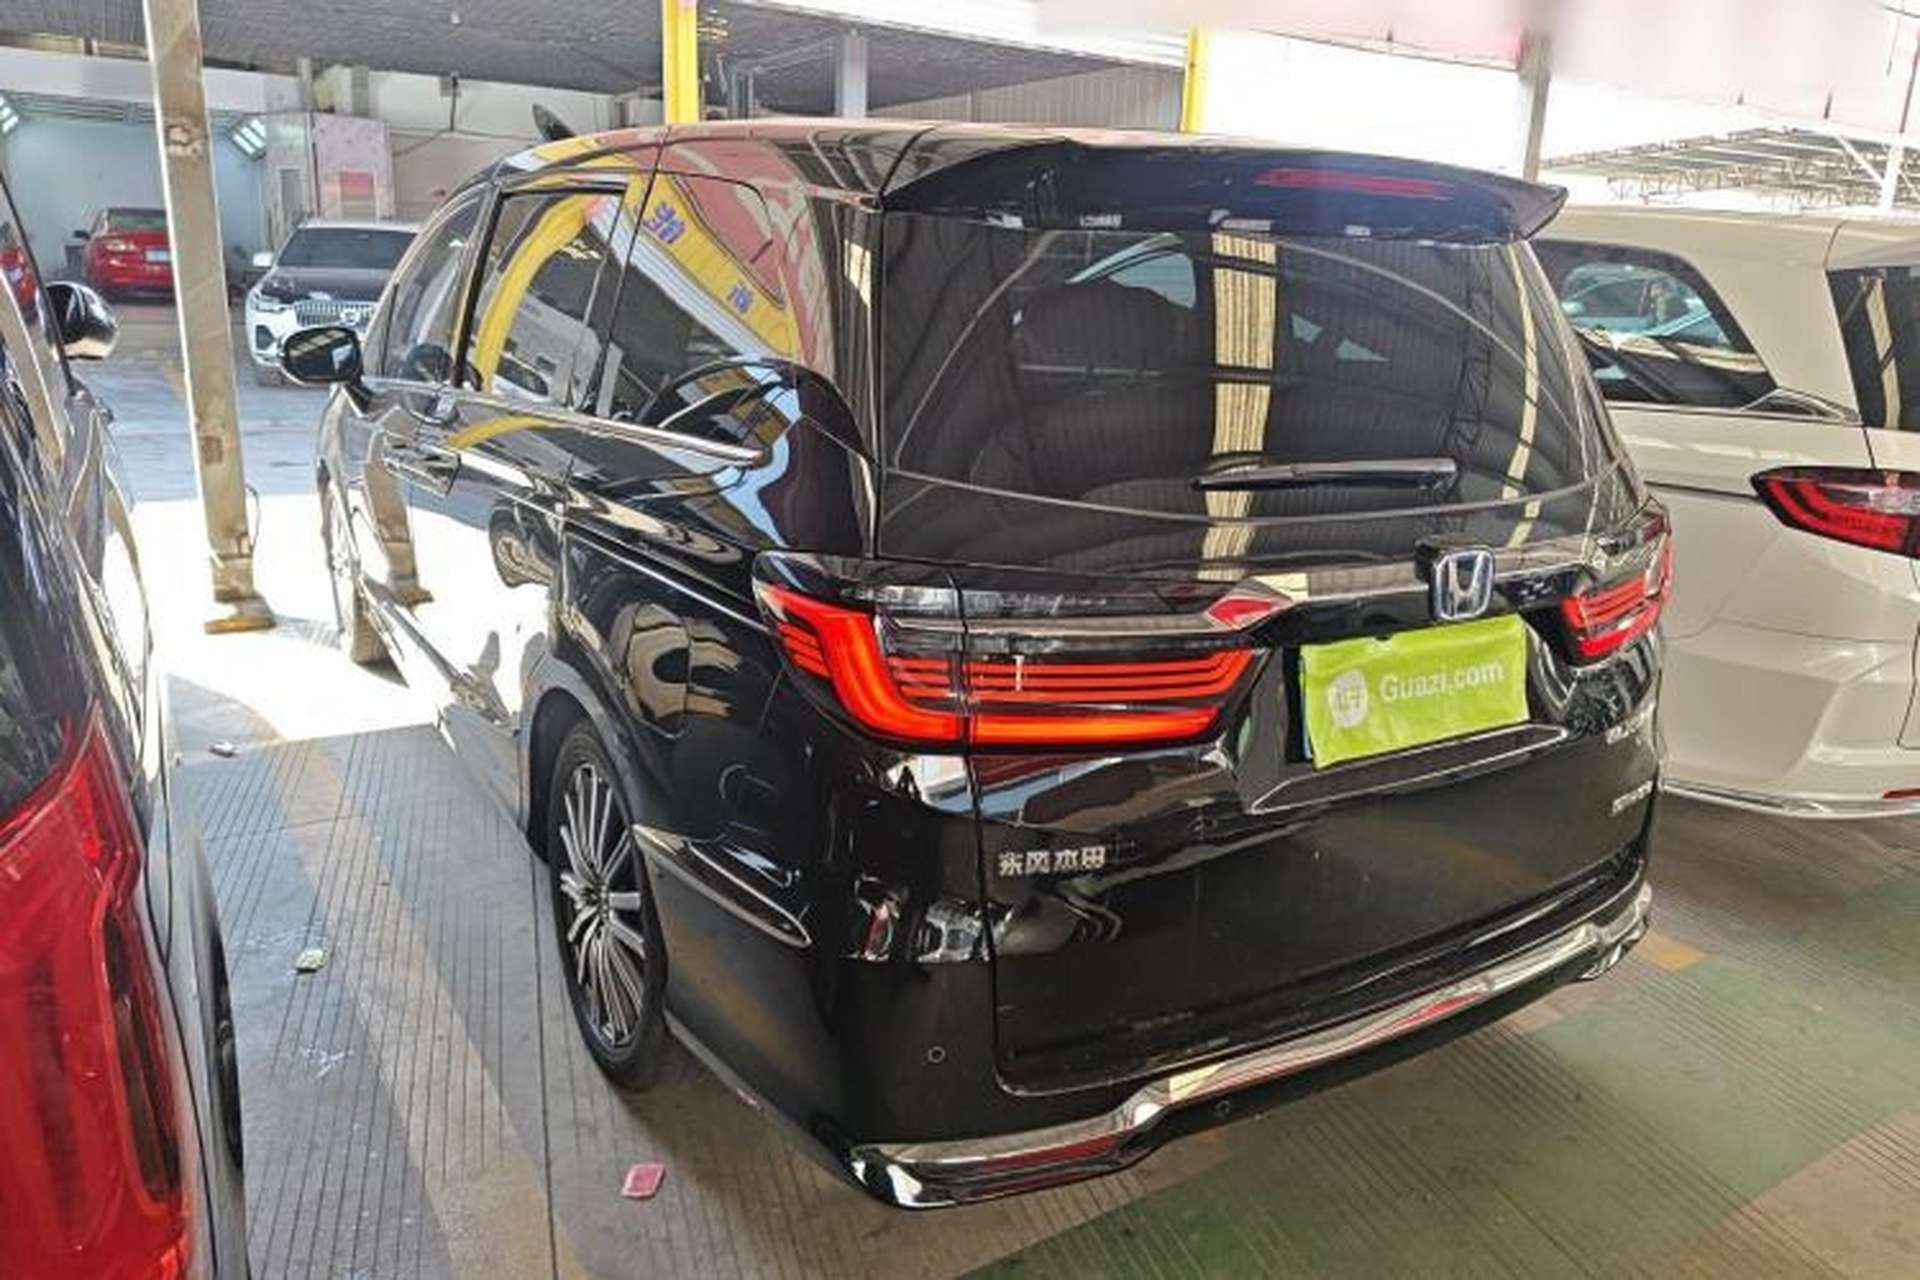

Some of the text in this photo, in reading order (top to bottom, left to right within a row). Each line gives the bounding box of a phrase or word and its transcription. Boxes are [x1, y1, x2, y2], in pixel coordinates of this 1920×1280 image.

[1379, 661, 1505, 701] Guazi.com
[998, 846, 1106, 877] 东风本田
